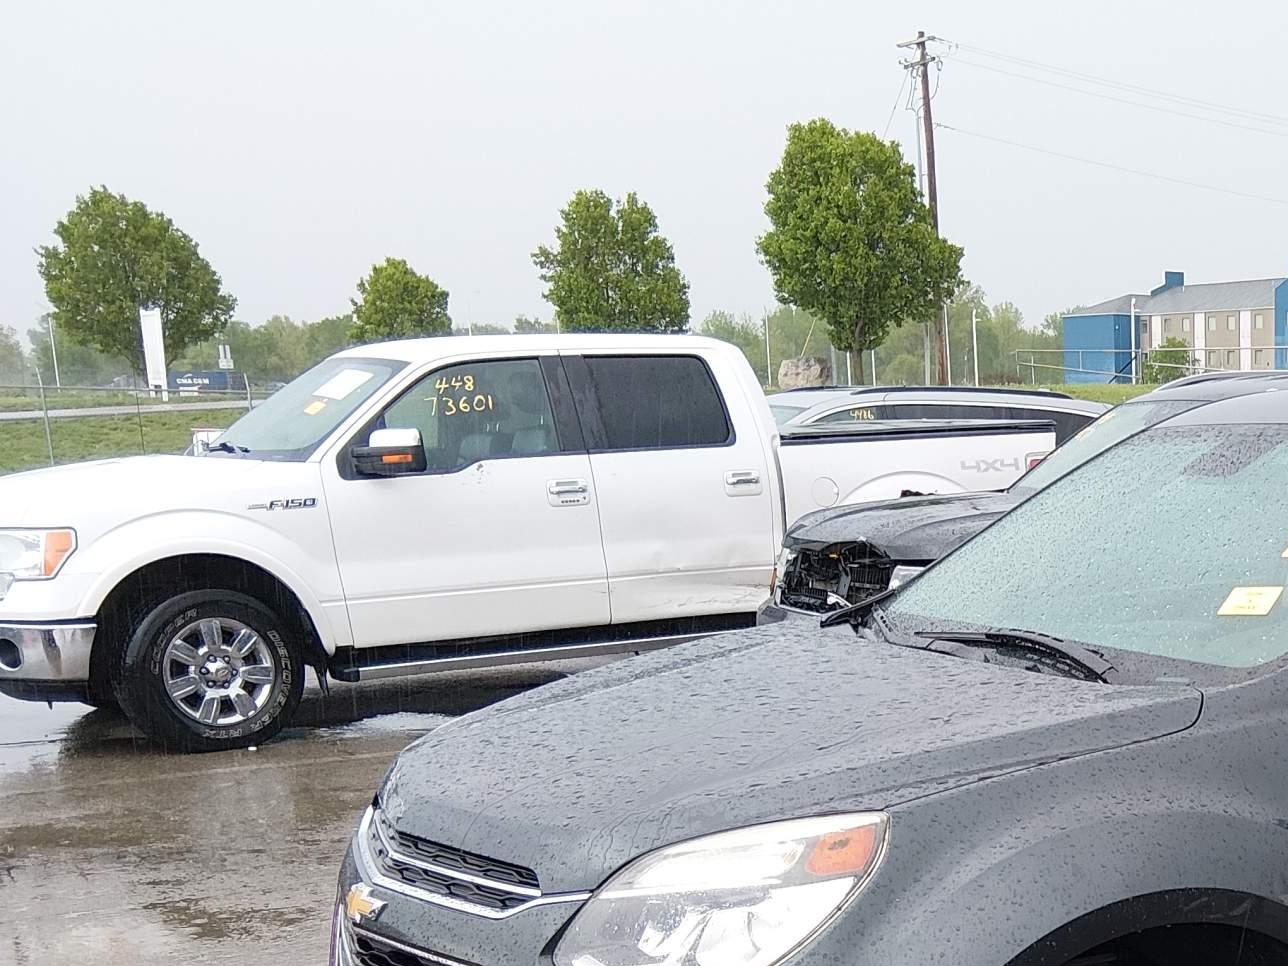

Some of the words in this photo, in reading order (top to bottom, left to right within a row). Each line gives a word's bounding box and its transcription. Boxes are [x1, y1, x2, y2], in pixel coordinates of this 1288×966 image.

[435, 374, 474, 394] 448
[424, 394, 493, 416] 73601
[151, 607, 198, 675] COOPER
